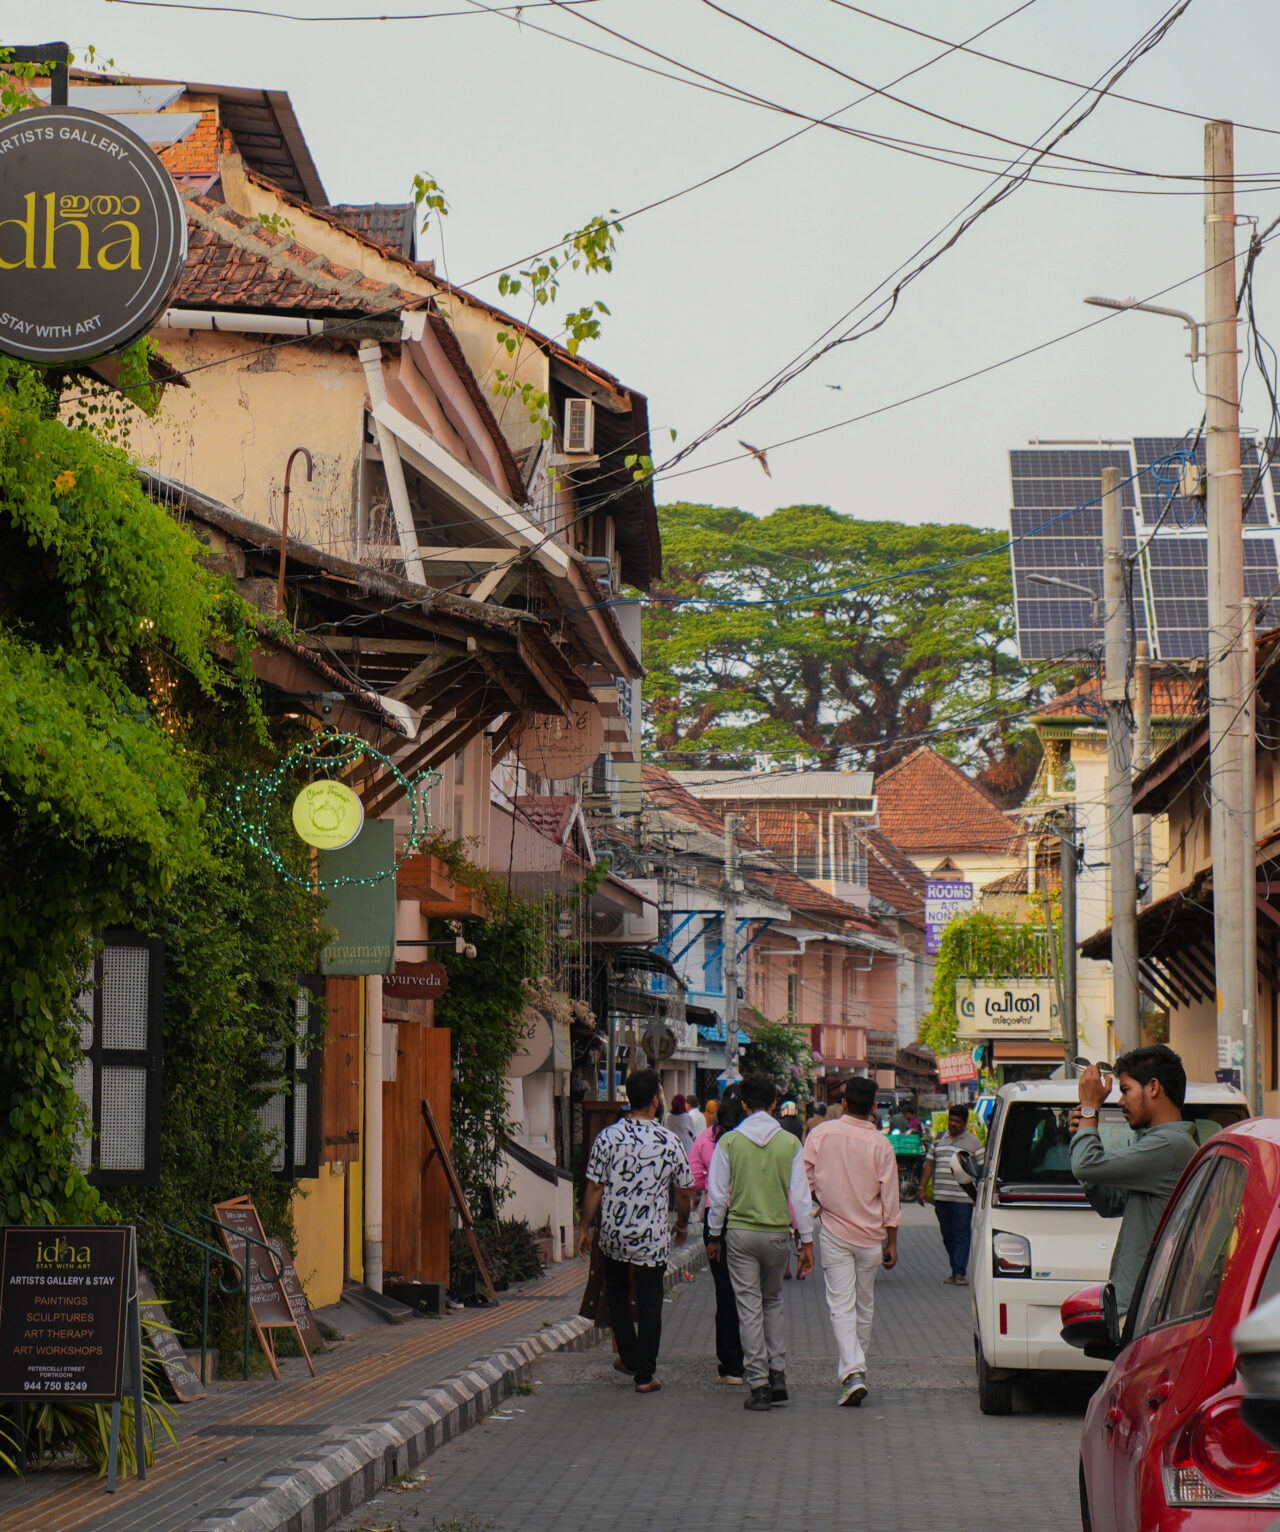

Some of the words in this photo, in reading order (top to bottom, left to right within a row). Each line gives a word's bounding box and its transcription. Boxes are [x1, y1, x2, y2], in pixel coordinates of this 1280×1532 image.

[59, 127, 129, 161] GALLERY
[60, 194, 140, 218] ഇതാ
[0, 312, 33, 337] STAY
[36, 324, 73, 338] WITH
[75, 314, 102, 336] ART
[927, 884, 972, 898] ROOMS
[941, 901, 959, 911] A/C
[324, 945, 391, 961] niraamaya
[382, 973, 441, 987] Ayurveda
[985, 991, 1040, 1017] പ്രീതി
[938, 1054, 973, 1069] ROOMS
[939, 1063, 975, 1079] AVAILABLE
[10, 1276, 45, 1285] ARTISTS
[46, 1276, 85, 1285] GALLERY
[85, 1276, 92, 1285] &
[93, 1276, 115, 1285] STAY
[34, 1296, 88, 1306] PAINTINGS
[26, 1313, 95, 1322] SCULPTURES
[24, 1329, 45, 1338] ART
[47, 1329, 95, 1339] THERAPY
[13, 1346, 34, 1355] ART
[36, 1346, 103, 1355] WORKSHOPS
[24, 1381, 42, 1391] 944
[44, 1381, 62, 1391] 750
[63, 1381, 88, 1391] 8249
